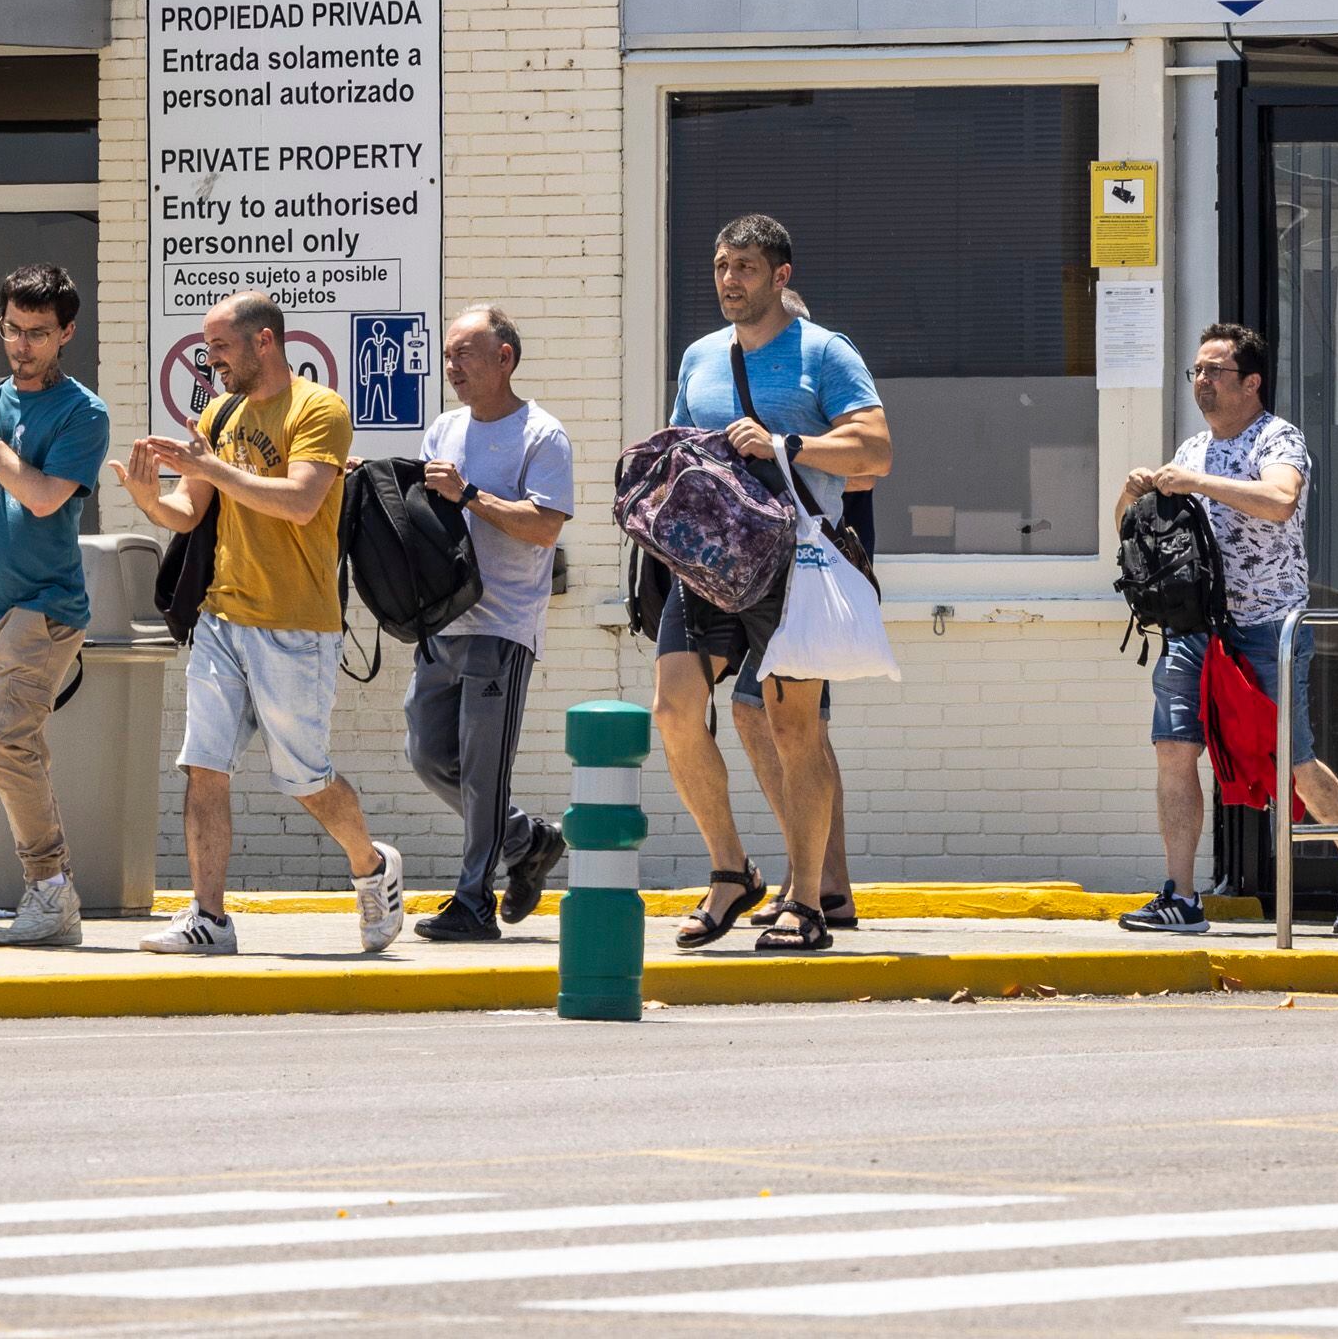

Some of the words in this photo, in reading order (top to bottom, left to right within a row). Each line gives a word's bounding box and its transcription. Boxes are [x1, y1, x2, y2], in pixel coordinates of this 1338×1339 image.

[161, 3, 304, 32] PROPIEDAD
[312, 0, 422, 27] PRIVADA
[163, 46, 260, 73] Entrada
[268, 43, 400, 70] solamente
[408, 47, 422, 67] a
[162, 82, 271, 115] personal
[279, 78, 415, 105] autorizado
[161, 146, 270, 174] PRIVATE
[279, 143, 423, 171] PROPERTY
[162, 195, 232, 225] Entry
[239, 195, 266, 219] to
[274, 190, 418, 218] authorised
[162, 228, 294, 262] personnel
[302, 228, 360, 259] only
[173, 268, 240, 286] Acceso
[245, 266, 301, 289] sujeto
[306, 270, 317, 284] a
[322, 265, 388, 286] posible
[270, 287, 336, 309] objetos
[238, 426, 245, 440] &
[247, 428, 282, 468] JONES
